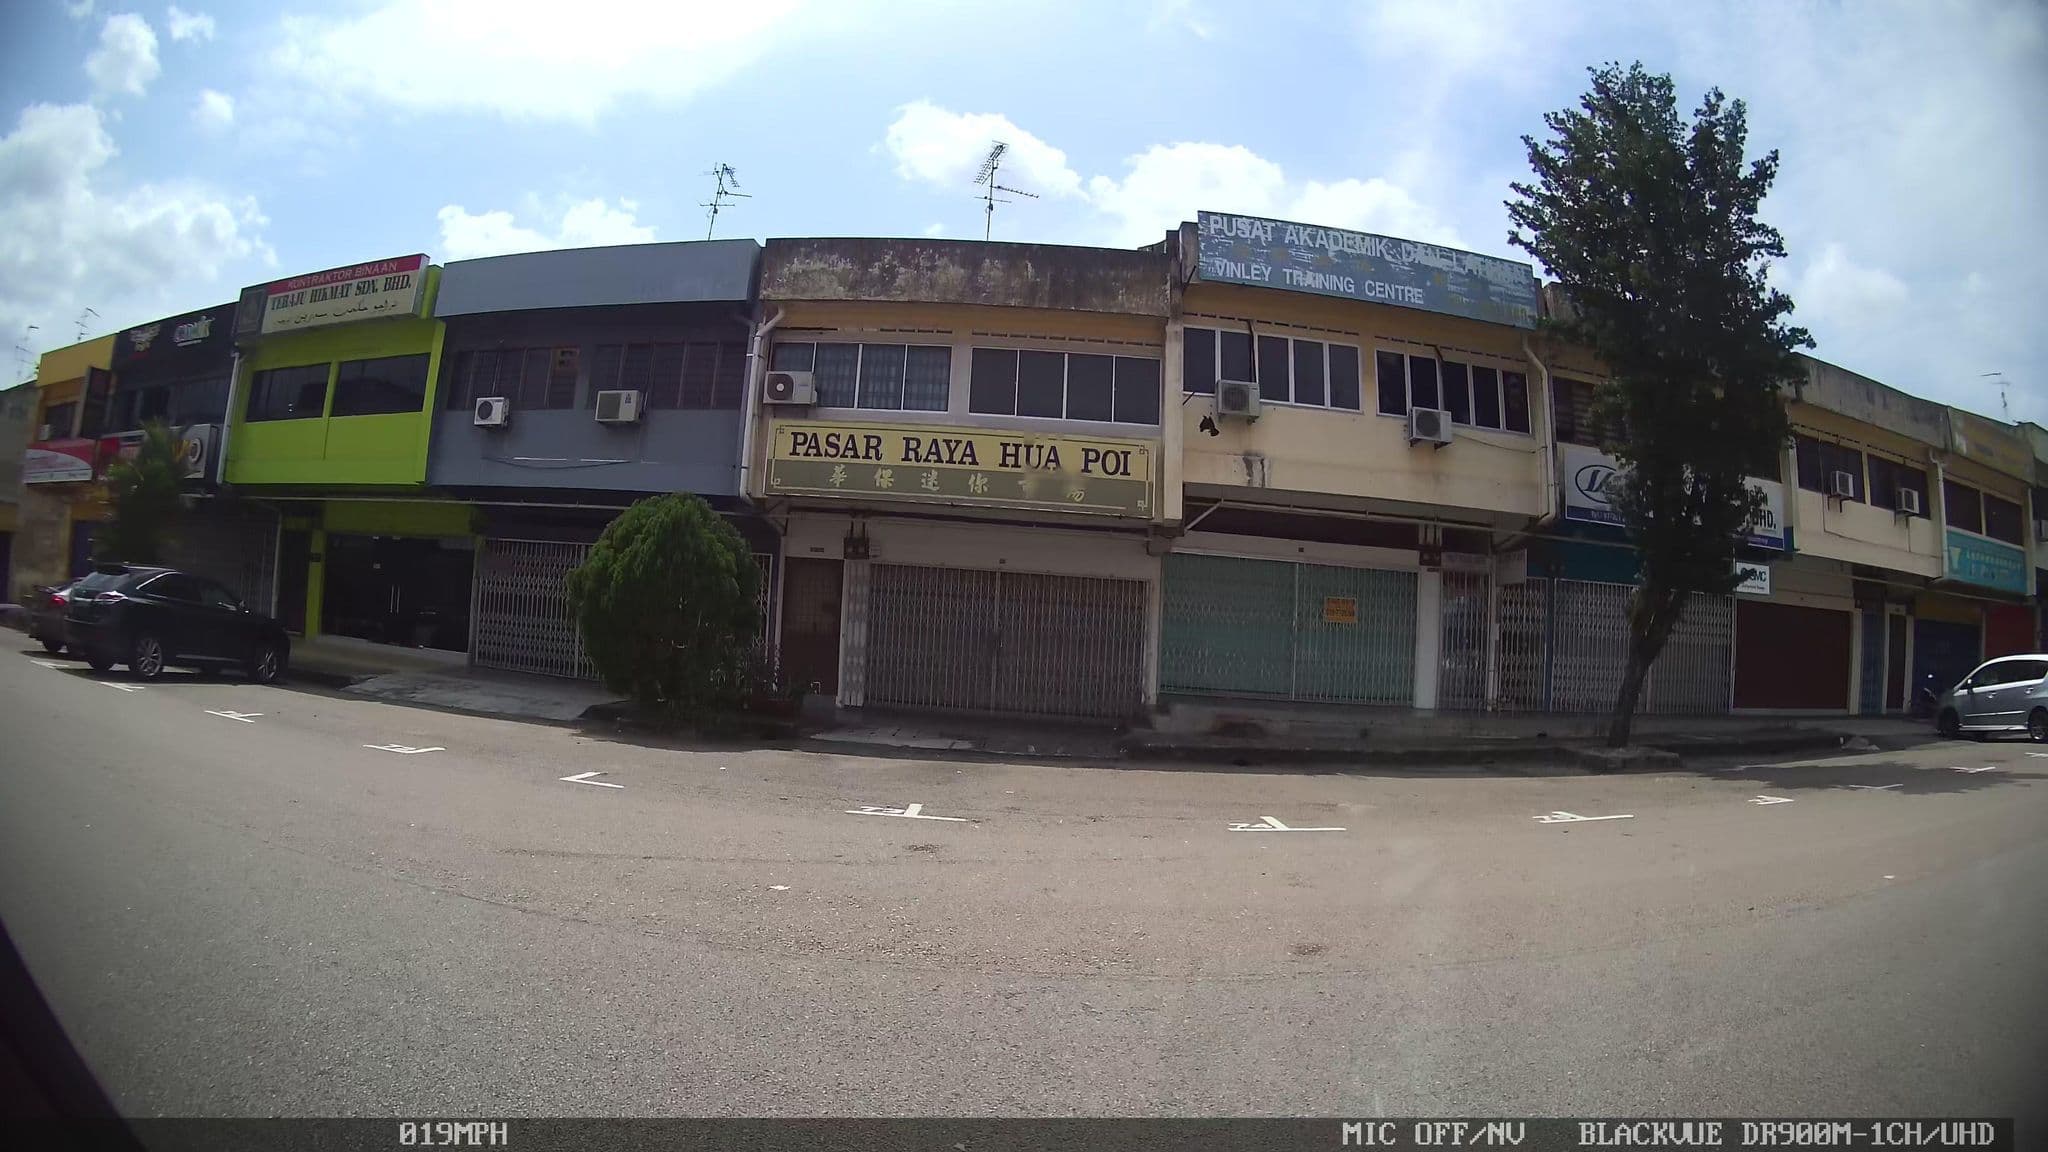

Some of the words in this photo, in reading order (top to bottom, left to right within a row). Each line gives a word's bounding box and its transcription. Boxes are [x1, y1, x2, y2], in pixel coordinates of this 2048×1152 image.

[1209, 215, 1276, 243] PUSAT
[1284, 225, 1387, 258] AKADEMIK
[288, 269, 352, 289] KONTRAKTOR
[354, 262, 398, 277] BINAAN
[309, 283, 352, 304] HIKMAT
[354, 279, 378, 297] SDN.
[383, 274, 411, 292] BHD.
[1215, 260, 1272, 282] VINLEY
[1283, 268, 1354, 294] TRAINING
[1365, 280, 1424, 305] CENTRE
[789, 431, 883, 462] PASAR
[901, 436, 979, 466] RAYA
[999, 442, 1062, 470] HUA
[1081, 448, 1131, 476] POI
